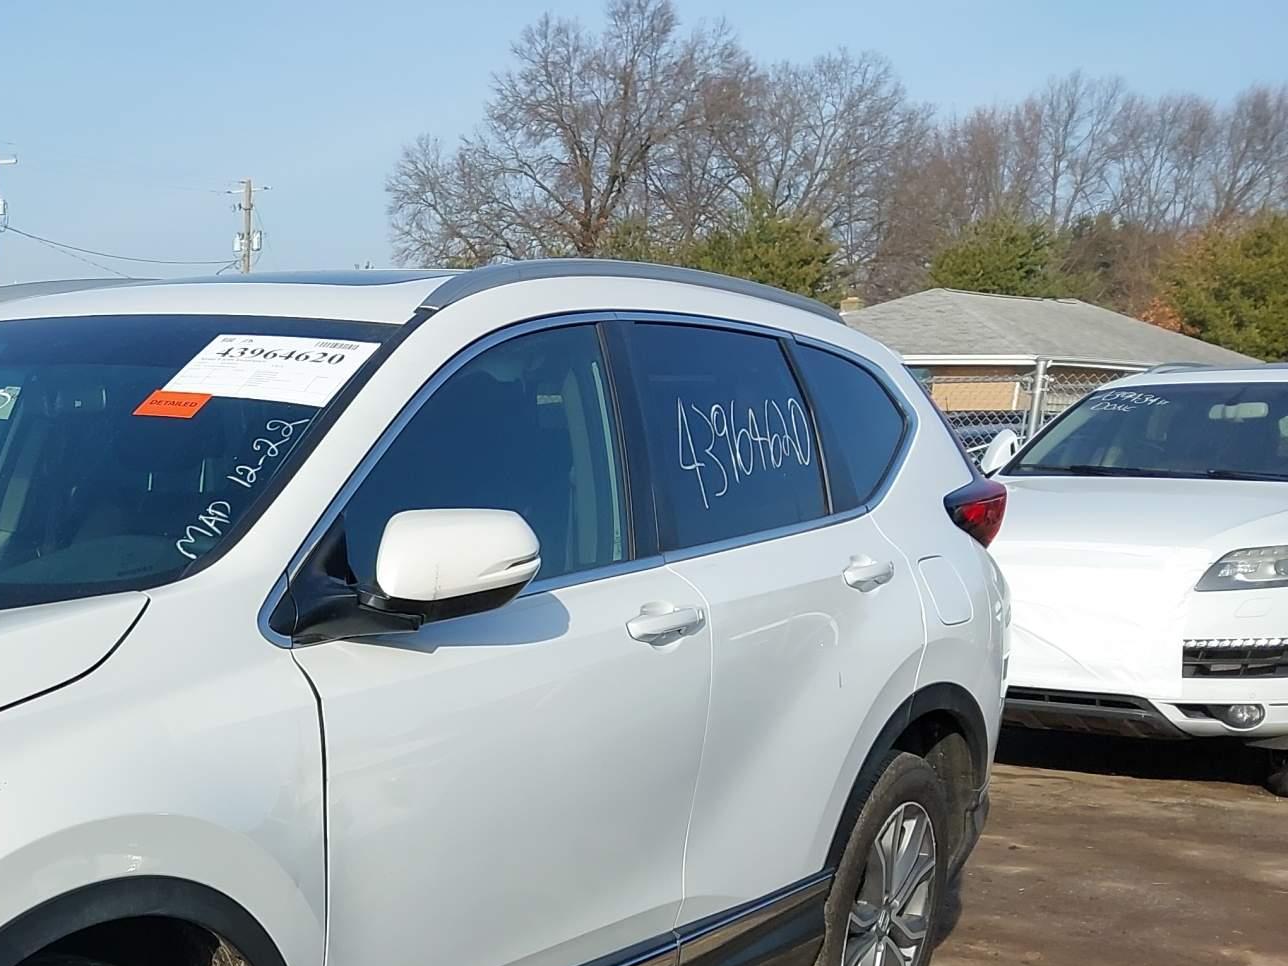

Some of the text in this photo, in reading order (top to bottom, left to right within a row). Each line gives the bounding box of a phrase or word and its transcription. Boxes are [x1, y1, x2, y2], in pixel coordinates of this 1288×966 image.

[216, 346, 346, 366] 43964620
[149, 399, 198, 408] DETAILED
[677, 397, 810, 509] 43964620
